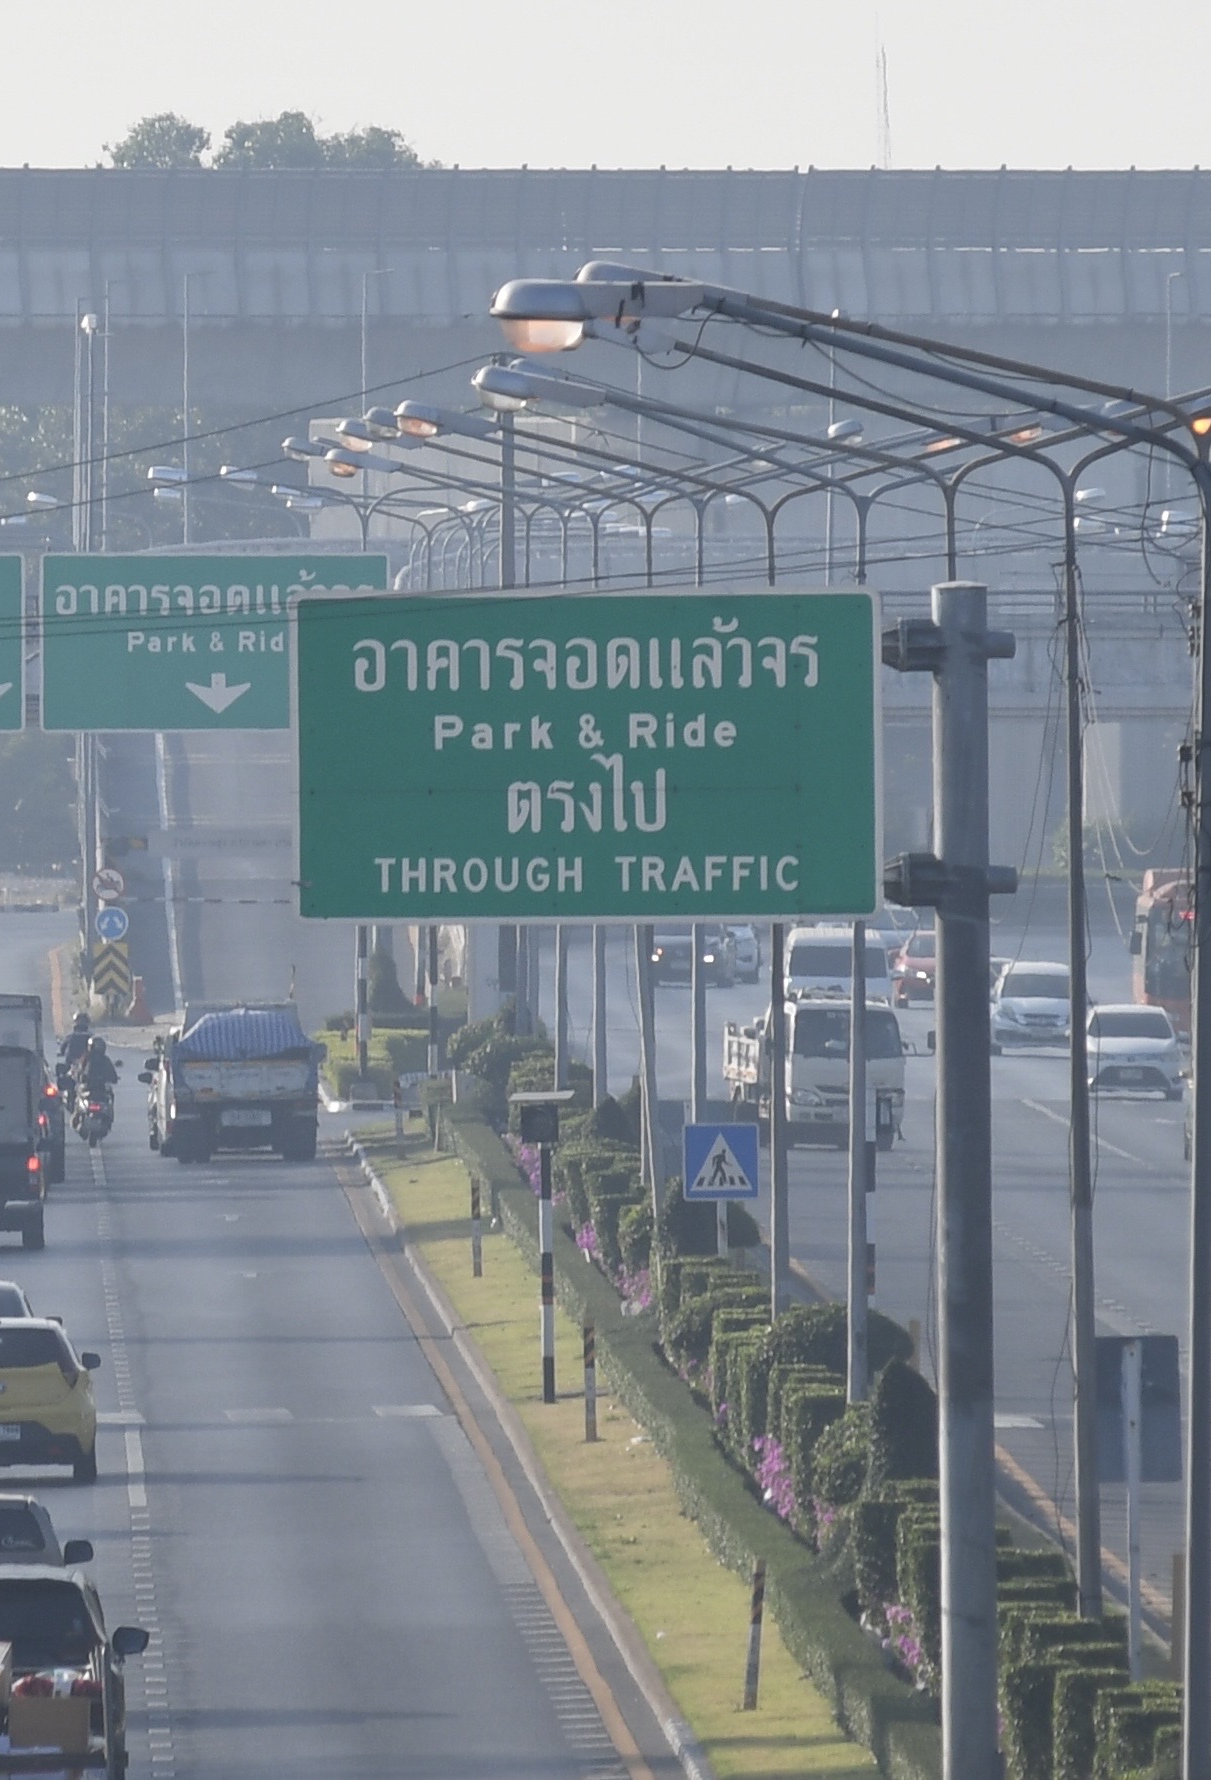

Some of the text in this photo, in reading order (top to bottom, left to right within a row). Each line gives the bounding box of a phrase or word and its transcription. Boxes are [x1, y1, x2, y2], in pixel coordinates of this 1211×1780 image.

[127, 630, 285, 653] Park & Rid
[353, 617, 819, 692] อาคารจอดแล้วจร
[434, 712, 737, 750] Park & Ride
[507, 753, 667, 834] ตรงไป
[374, 855, 799, 893] THROUGH TRAFFIC
